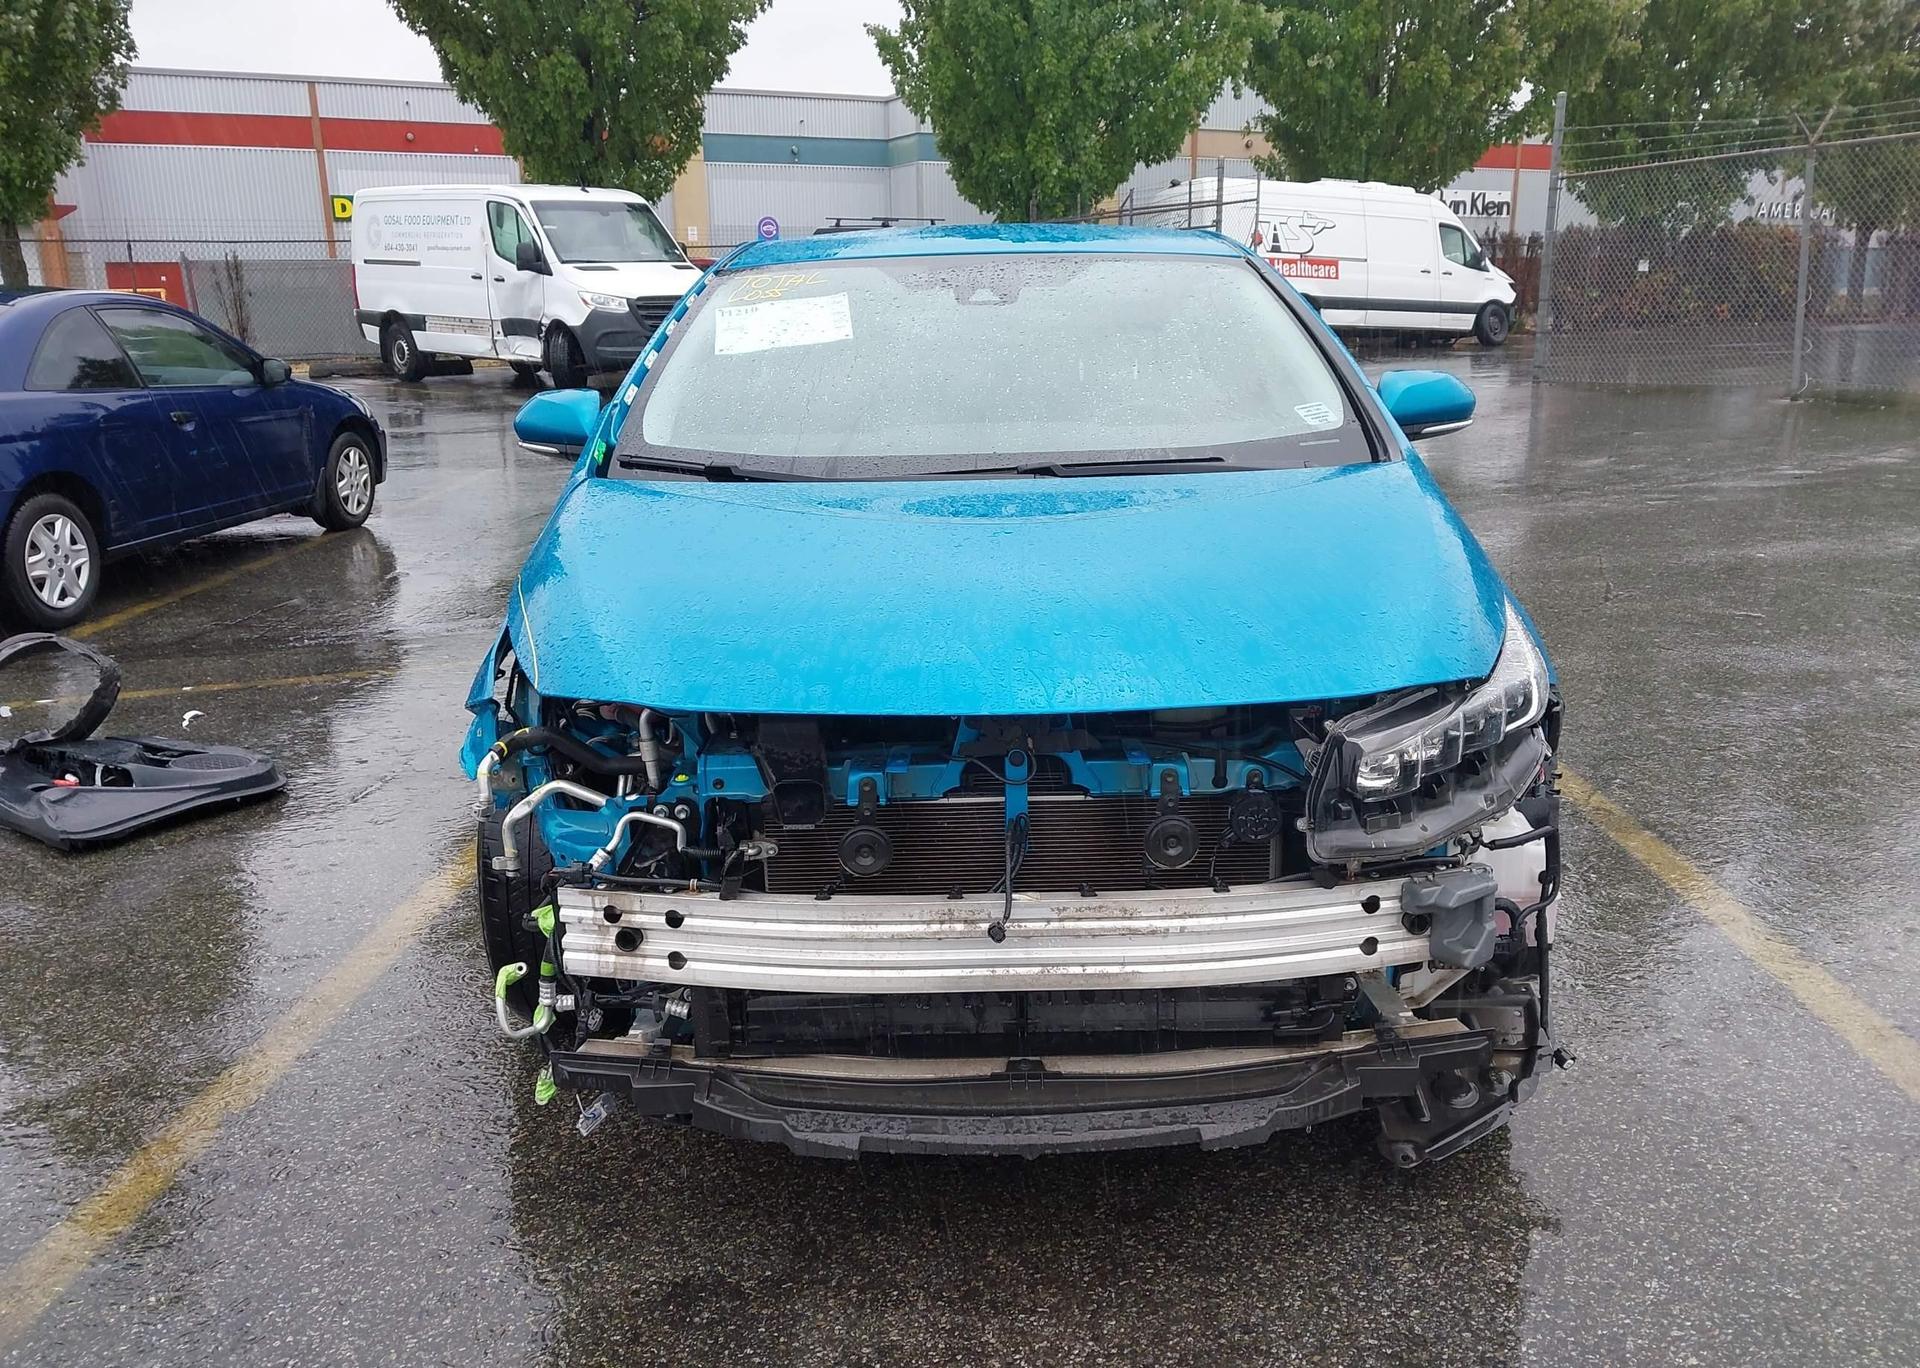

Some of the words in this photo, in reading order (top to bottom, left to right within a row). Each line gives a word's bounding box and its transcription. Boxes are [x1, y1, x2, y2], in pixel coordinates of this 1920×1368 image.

[1470, 192, 1511, 216] Klein
[383, 214, 402, 226] GOSAL
[404, 214, 421, 226] FOOD
[422, 214, 459, 226] EQUIPMENT
[460, 215, 472, 226] LTD
[1274, 259, 1337, 278] Healthcare
[734, 271, 828, 289] TOTAL
[728, 287, 790, 303] LOSS
